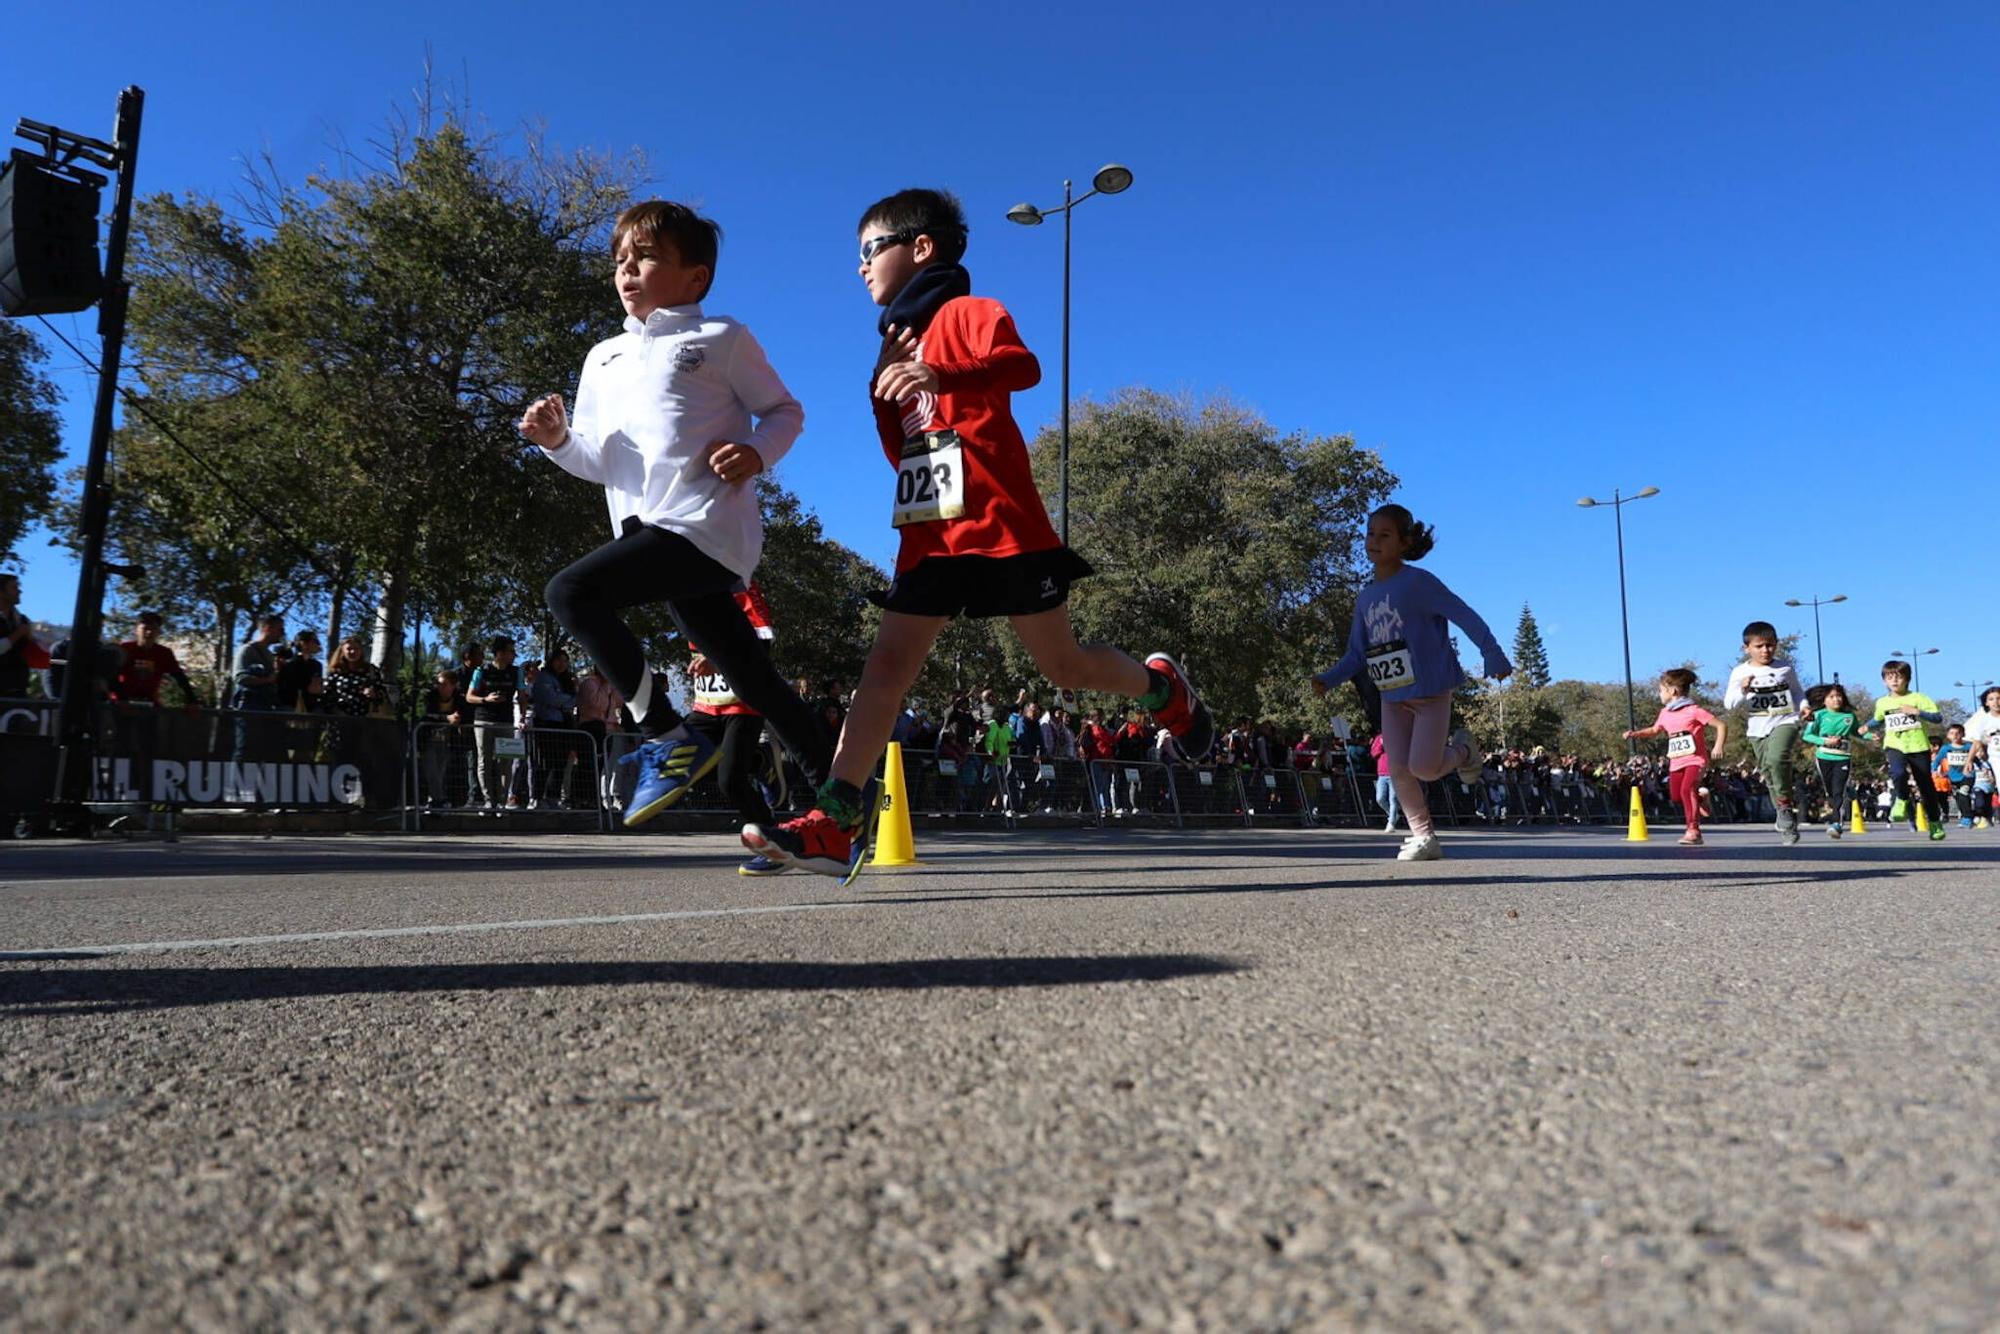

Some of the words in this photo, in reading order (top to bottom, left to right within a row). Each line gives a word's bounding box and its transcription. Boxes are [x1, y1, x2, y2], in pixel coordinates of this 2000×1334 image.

[697, 673, 730, 692] 023
[1752, 694, 1788, 710] 2023
[1888, 713, 1917, 728] 2023
[152, 758, 363, 805] RUNNING
